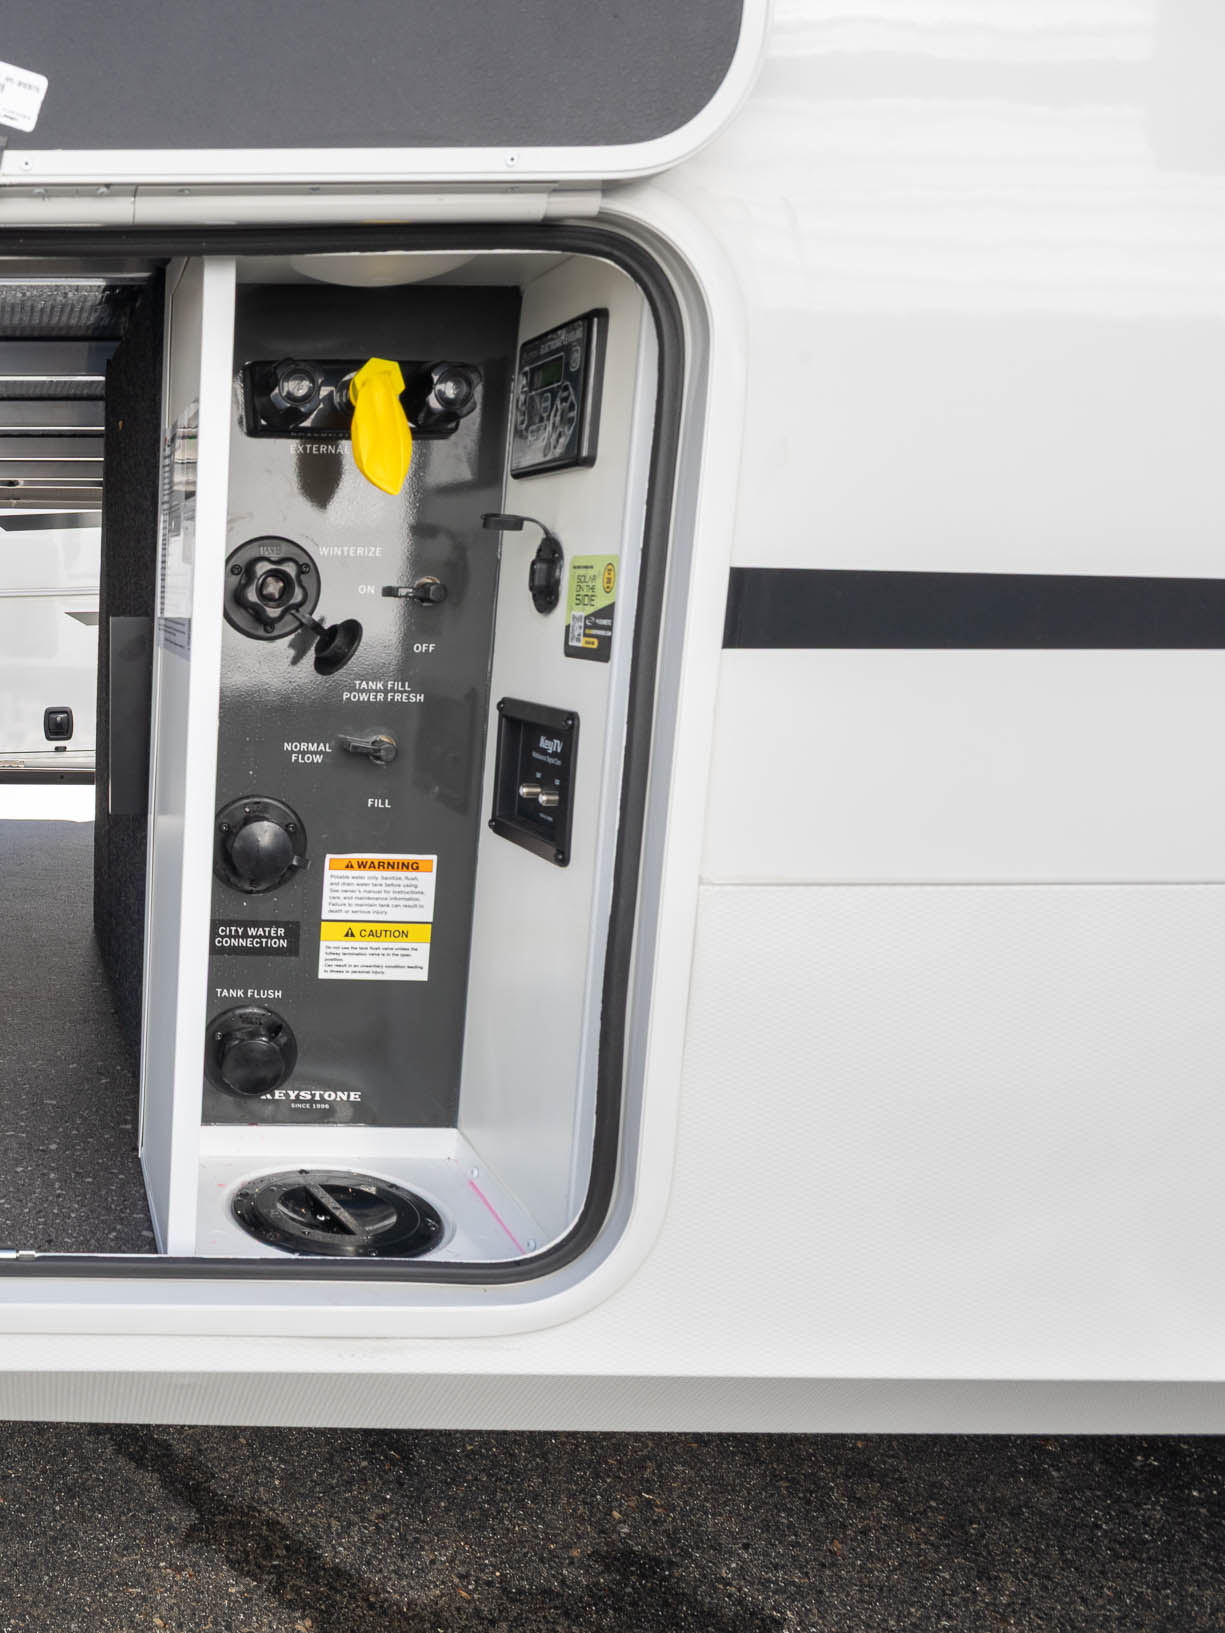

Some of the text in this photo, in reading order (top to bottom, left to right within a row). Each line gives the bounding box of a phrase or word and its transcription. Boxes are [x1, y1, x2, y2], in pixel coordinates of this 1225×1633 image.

[290, 444, 350, 455] EXTERNAL
[319, 546, 384, 557] WINTERIZE
[358, 584, 375, 595] ON
[413, 643, 436, 654] OFF
[354, 680, 412, 691] TANK FILL
[343, 692, 424, 702] POWER FRESH
[284, 742, 332, 752] NORMAL
[539, 735, 564, 753] KeyTV
[291, 754, 324, 764] FLOW
[368, 798, 392, 808] FILL
[356, 860, 420, 871] WARNING
[218, 926, 286, 937] CITY WATER
[359, 929, 409, 939] CAUTION
[214, 937, 288, 948] CONNECTION
[215, 988, 282, 999] TANK FLUSH
